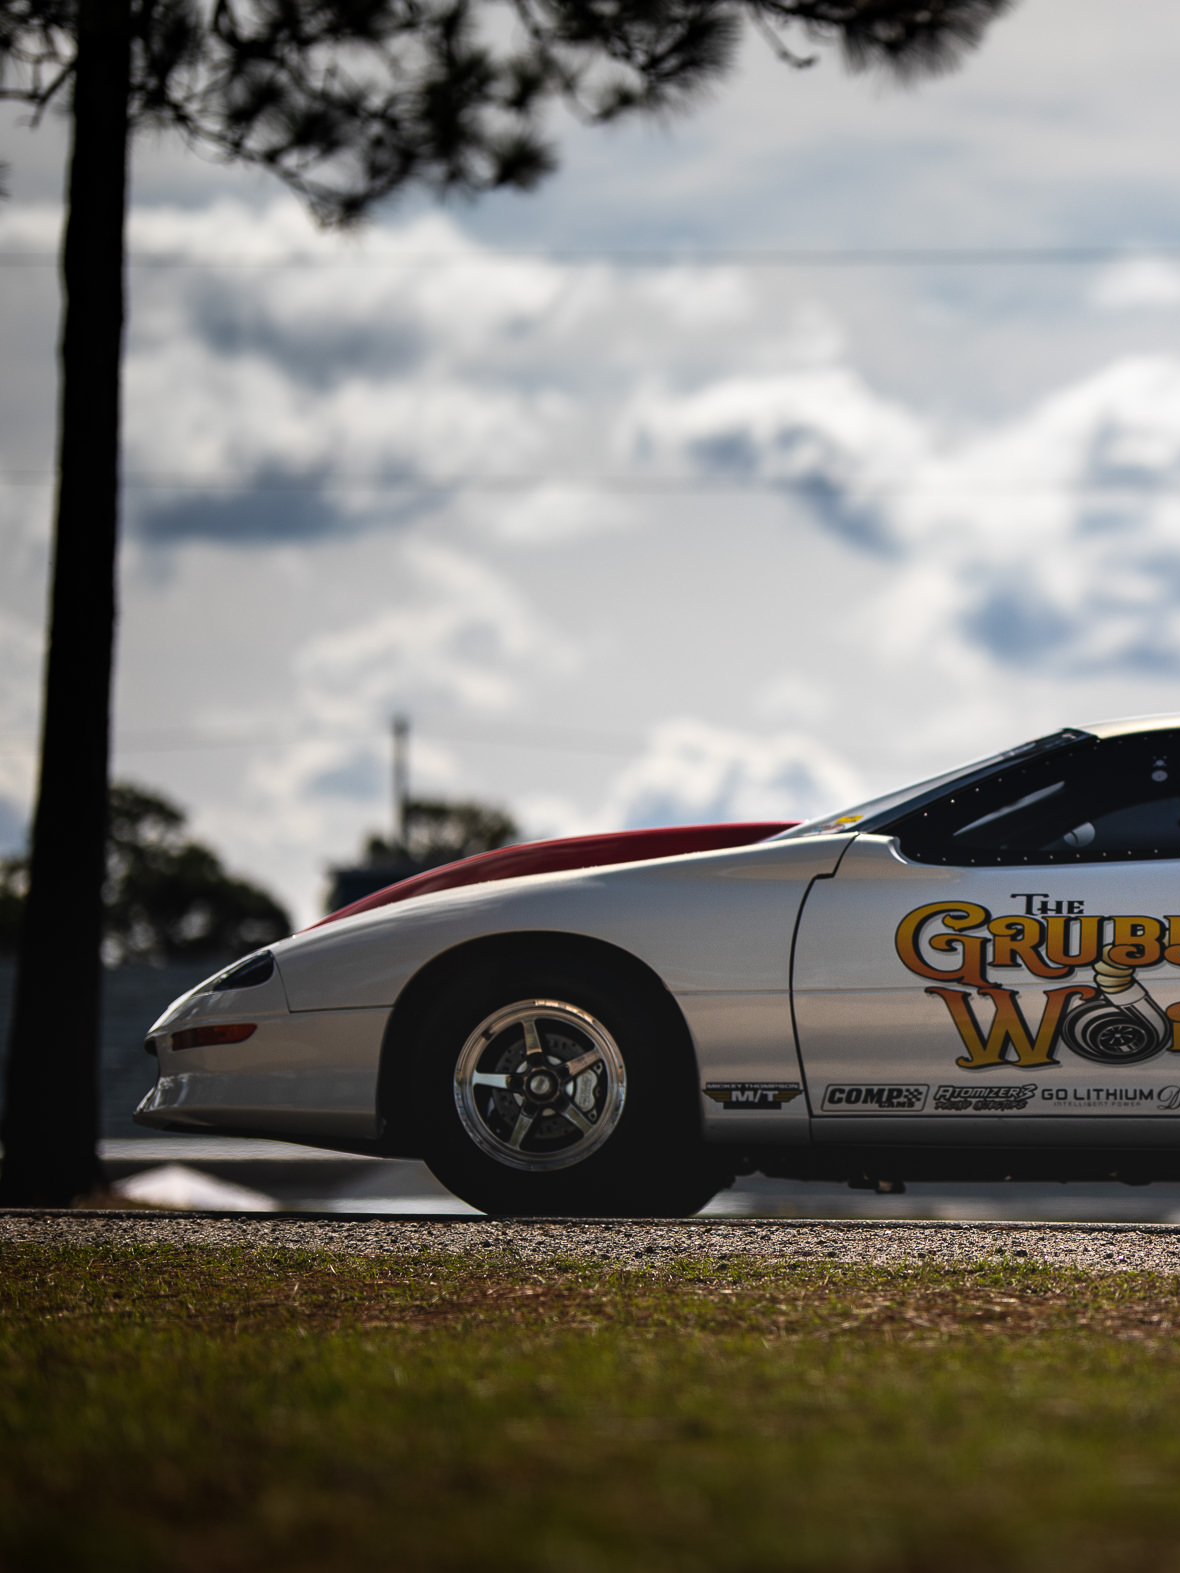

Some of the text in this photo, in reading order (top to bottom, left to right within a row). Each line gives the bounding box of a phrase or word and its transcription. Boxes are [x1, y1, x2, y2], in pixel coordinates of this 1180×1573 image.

[731, 1090, 779, 1103] M/T
[827, 1087, 904, 1105] COMP
[1041, 1088, 1154, 1101] GO LITHIUM
